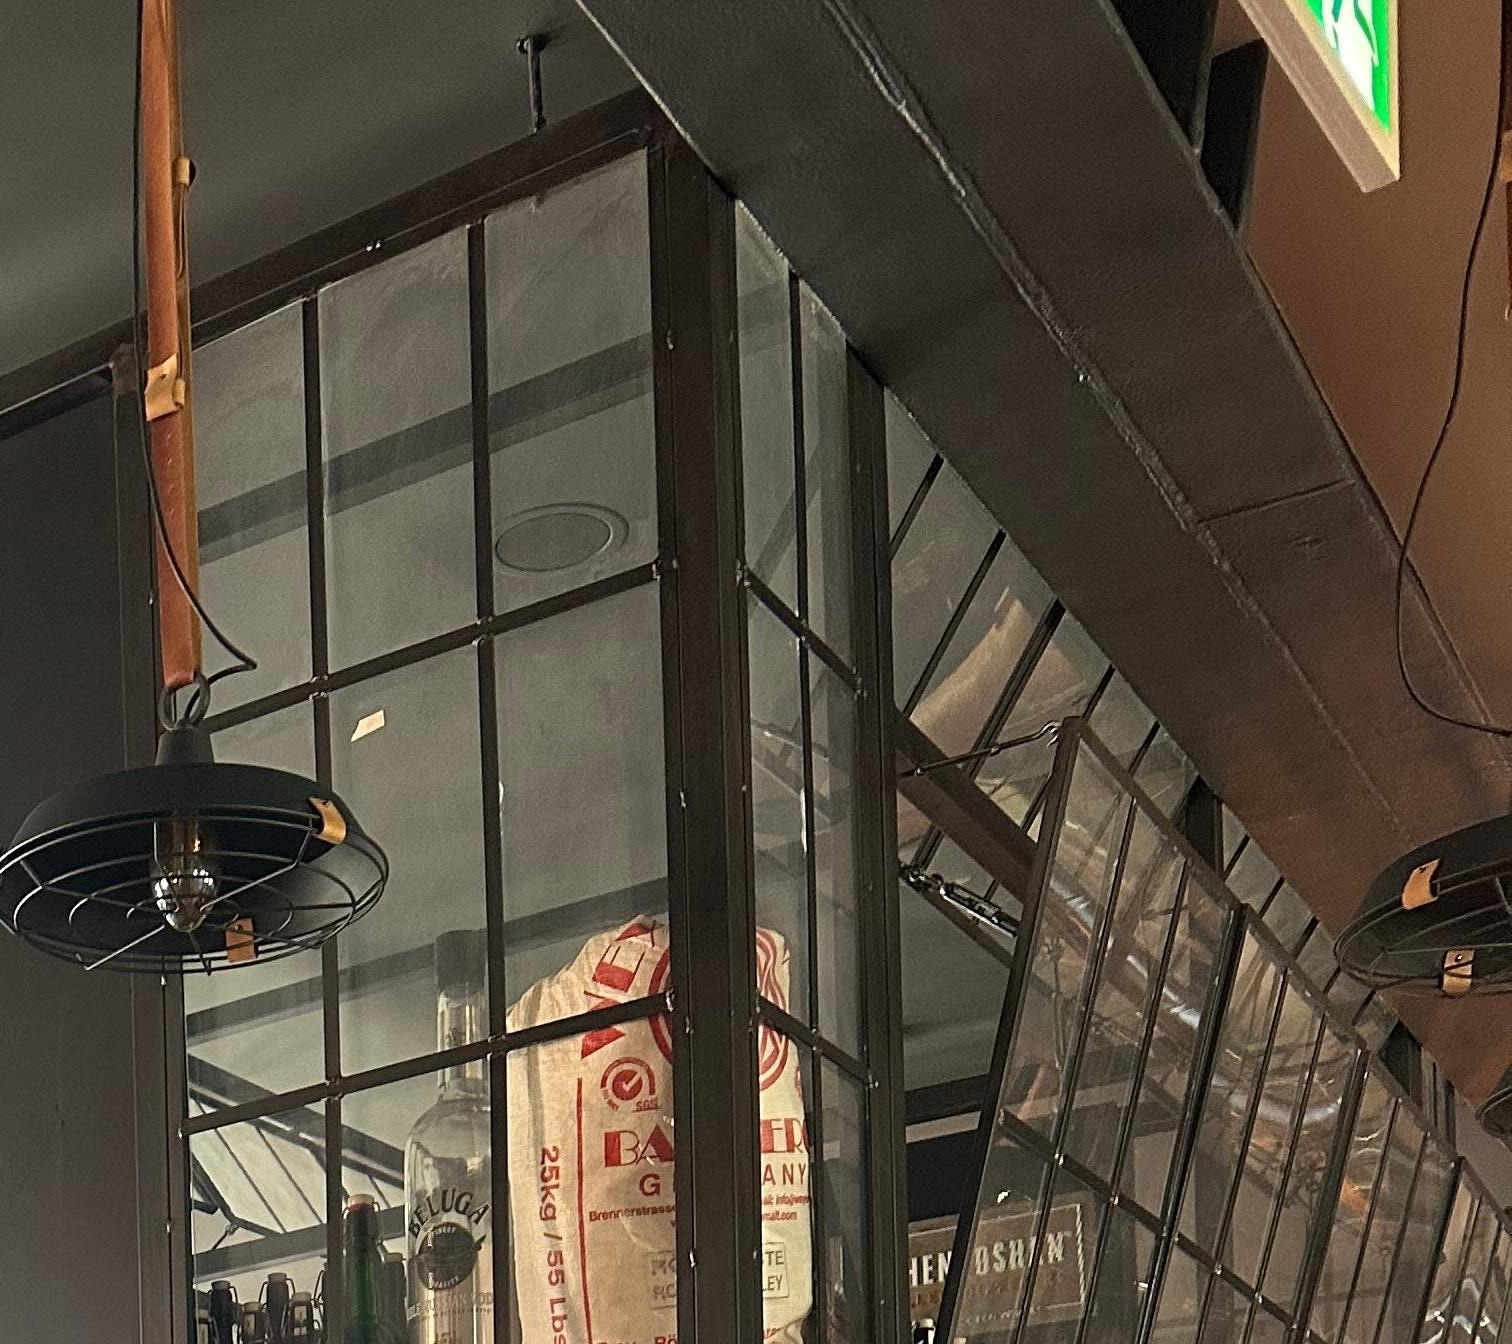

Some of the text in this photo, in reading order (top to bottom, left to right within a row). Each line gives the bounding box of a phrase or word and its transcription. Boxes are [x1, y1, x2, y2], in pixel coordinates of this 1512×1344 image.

[539, 1146, 560, 1221] 25kg
[409, 1187, 489, 1239] BELUGA
[545, 1249, 566, 1287] 55
